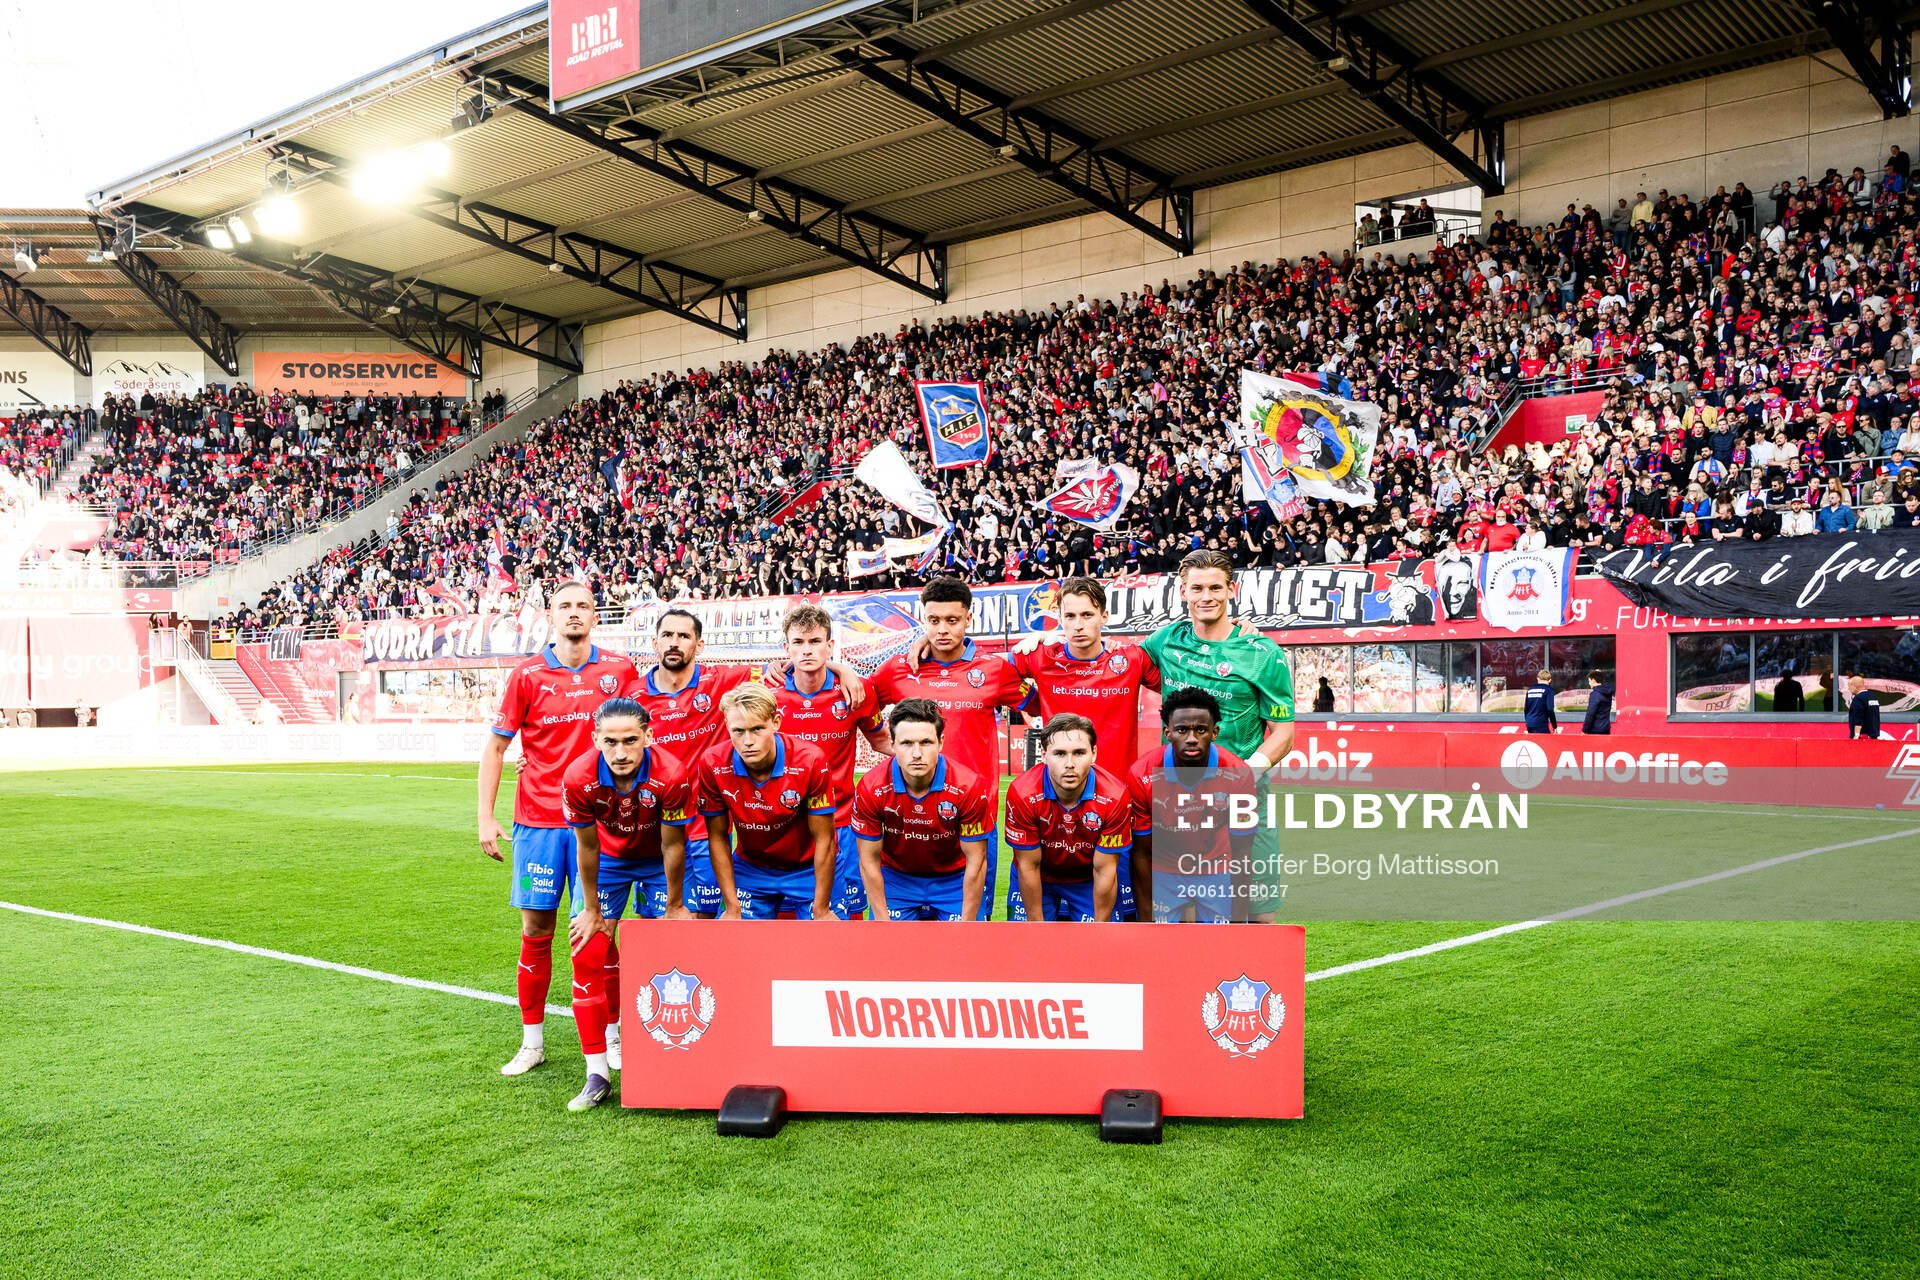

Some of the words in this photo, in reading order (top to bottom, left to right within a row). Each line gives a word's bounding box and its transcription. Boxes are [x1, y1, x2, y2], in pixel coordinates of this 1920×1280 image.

[566, 50, 590, 67] ROAD
[590, 38, 624, 58] RENTAL
[282, 363, 438, 379] STORSERVICE
[114, 378, 182, 390] Söderåsens
[1760, 554, 1792, 585] i
[1113, 575, 1159, 588] ACAB
[1515, 585, 1531, 595] HIF
[1052, 684, 1100, 697] letusplay
[1101, 686, 1131, 697] group
[954, 699, 984, 710] group
[1269, 703, 1291, 718] XXL
[543, 711, 590, 725] letusplay
[688, 723, 717, 739] group
[820, 731, 850, 741] group
[1270, 737, 1373, 782] bbiz
[1552, 750, 1729, 786] AllOffice
[662, 808, 687, 821] XXL
[960, 821, 985, 836] XXL
[1100, 833, 1124, 848] XXL
[527, 862, 554, 875] Fibio
[533, 877, 554, 888] Solid
[697, 885, 720, 897] Fibio
[825, 990, 1089, 1040] NORRVIDINGE
